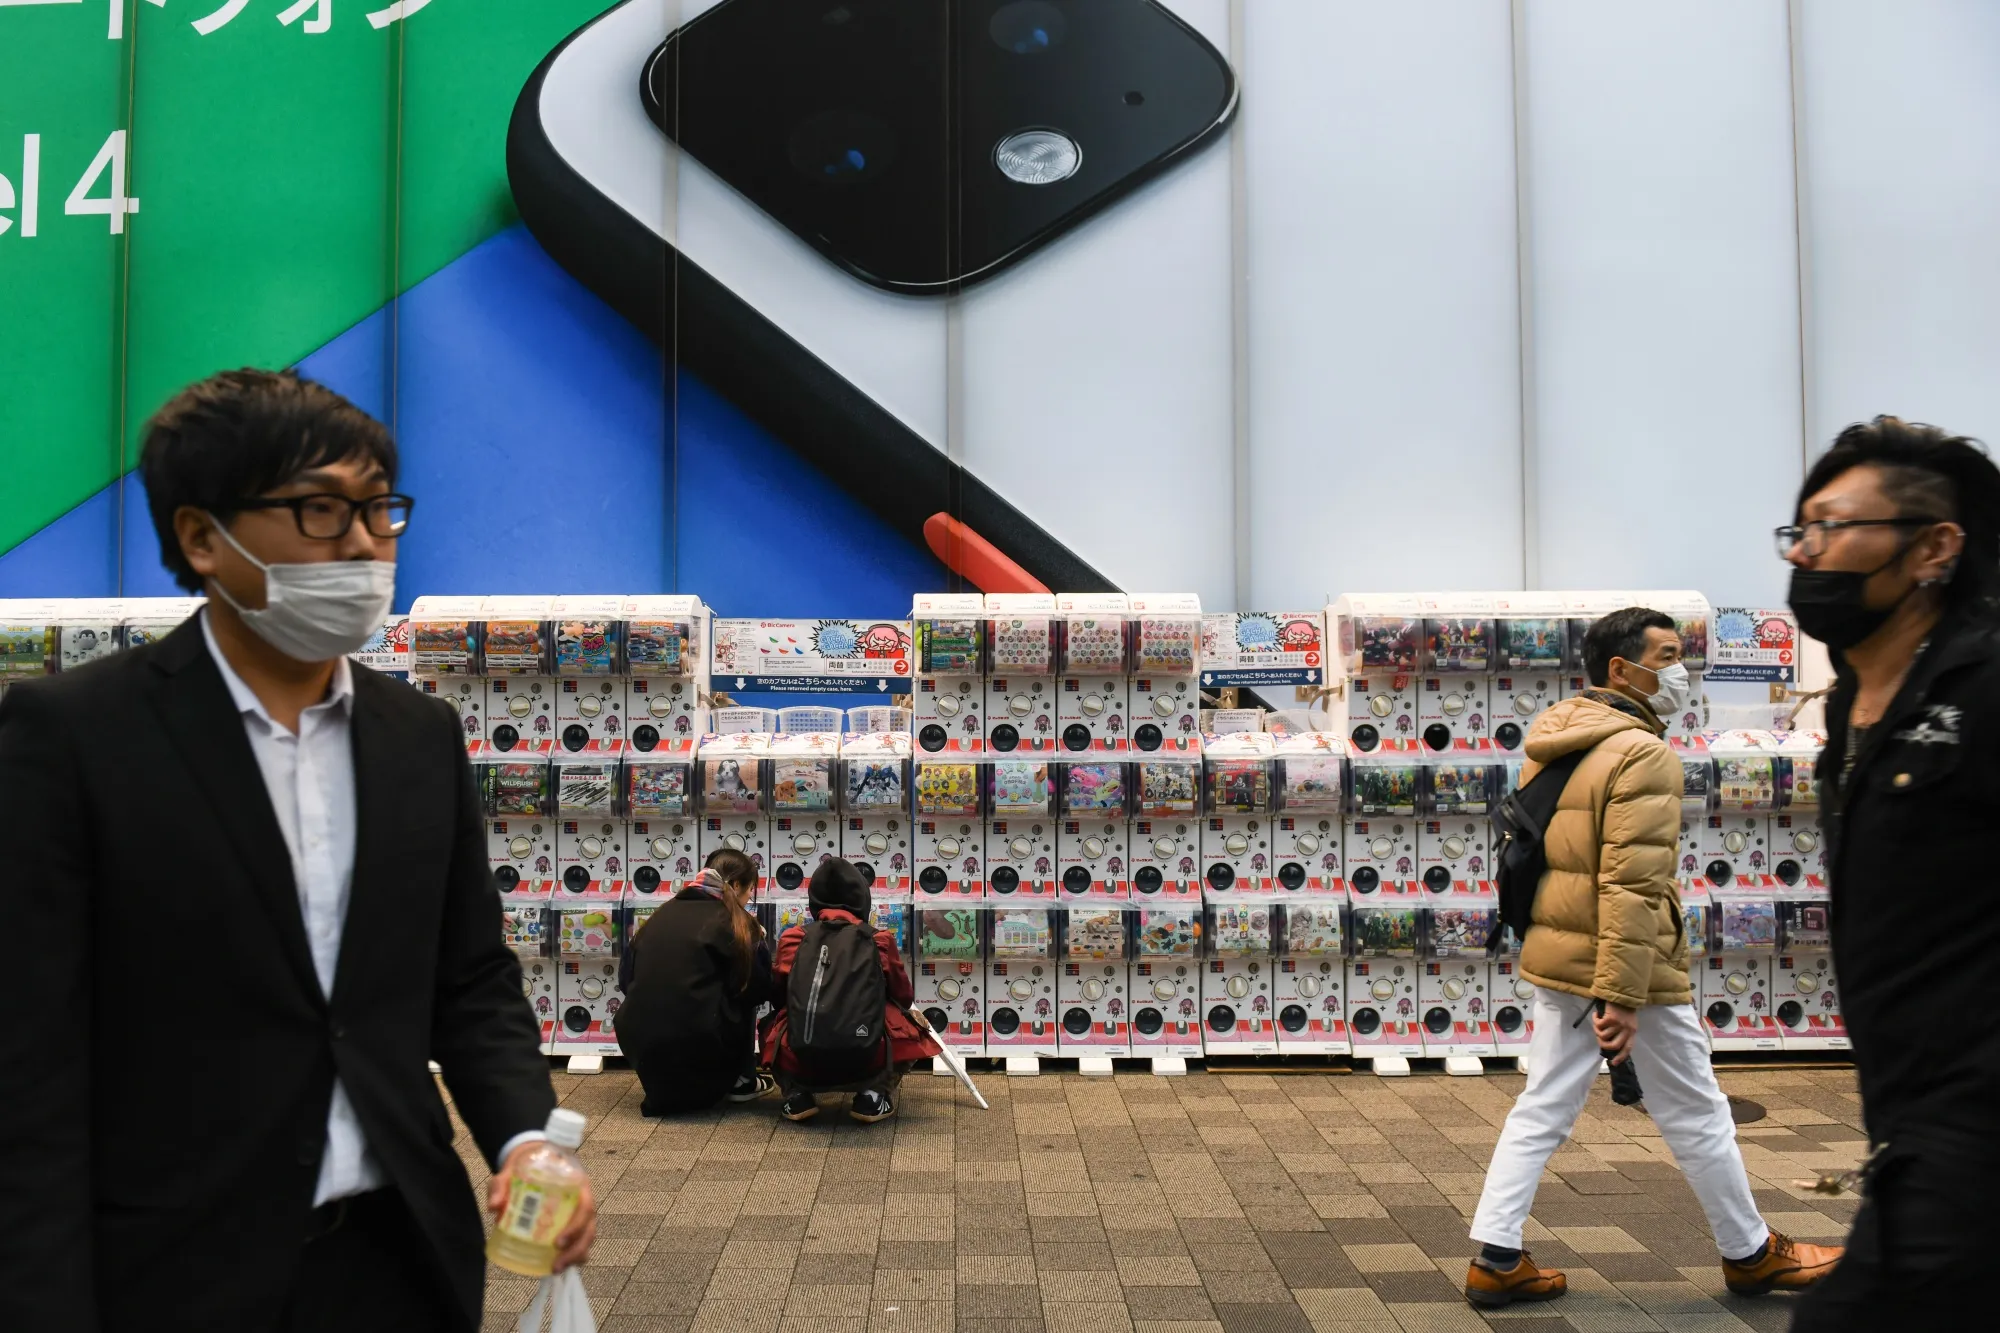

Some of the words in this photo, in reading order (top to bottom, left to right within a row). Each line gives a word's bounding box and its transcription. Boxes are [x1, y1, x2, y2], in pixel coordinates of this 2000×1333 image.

[0, 134, 40, 237] l
[64, 129, 140, 235] 4
[359, 655, 374, 663] 両替
[1239, 655, 1255, 663] 両替
[828, 661, 844, 669] 両替
[757, 678, 867, 686] 空のカプセルはこちらへお入れください
